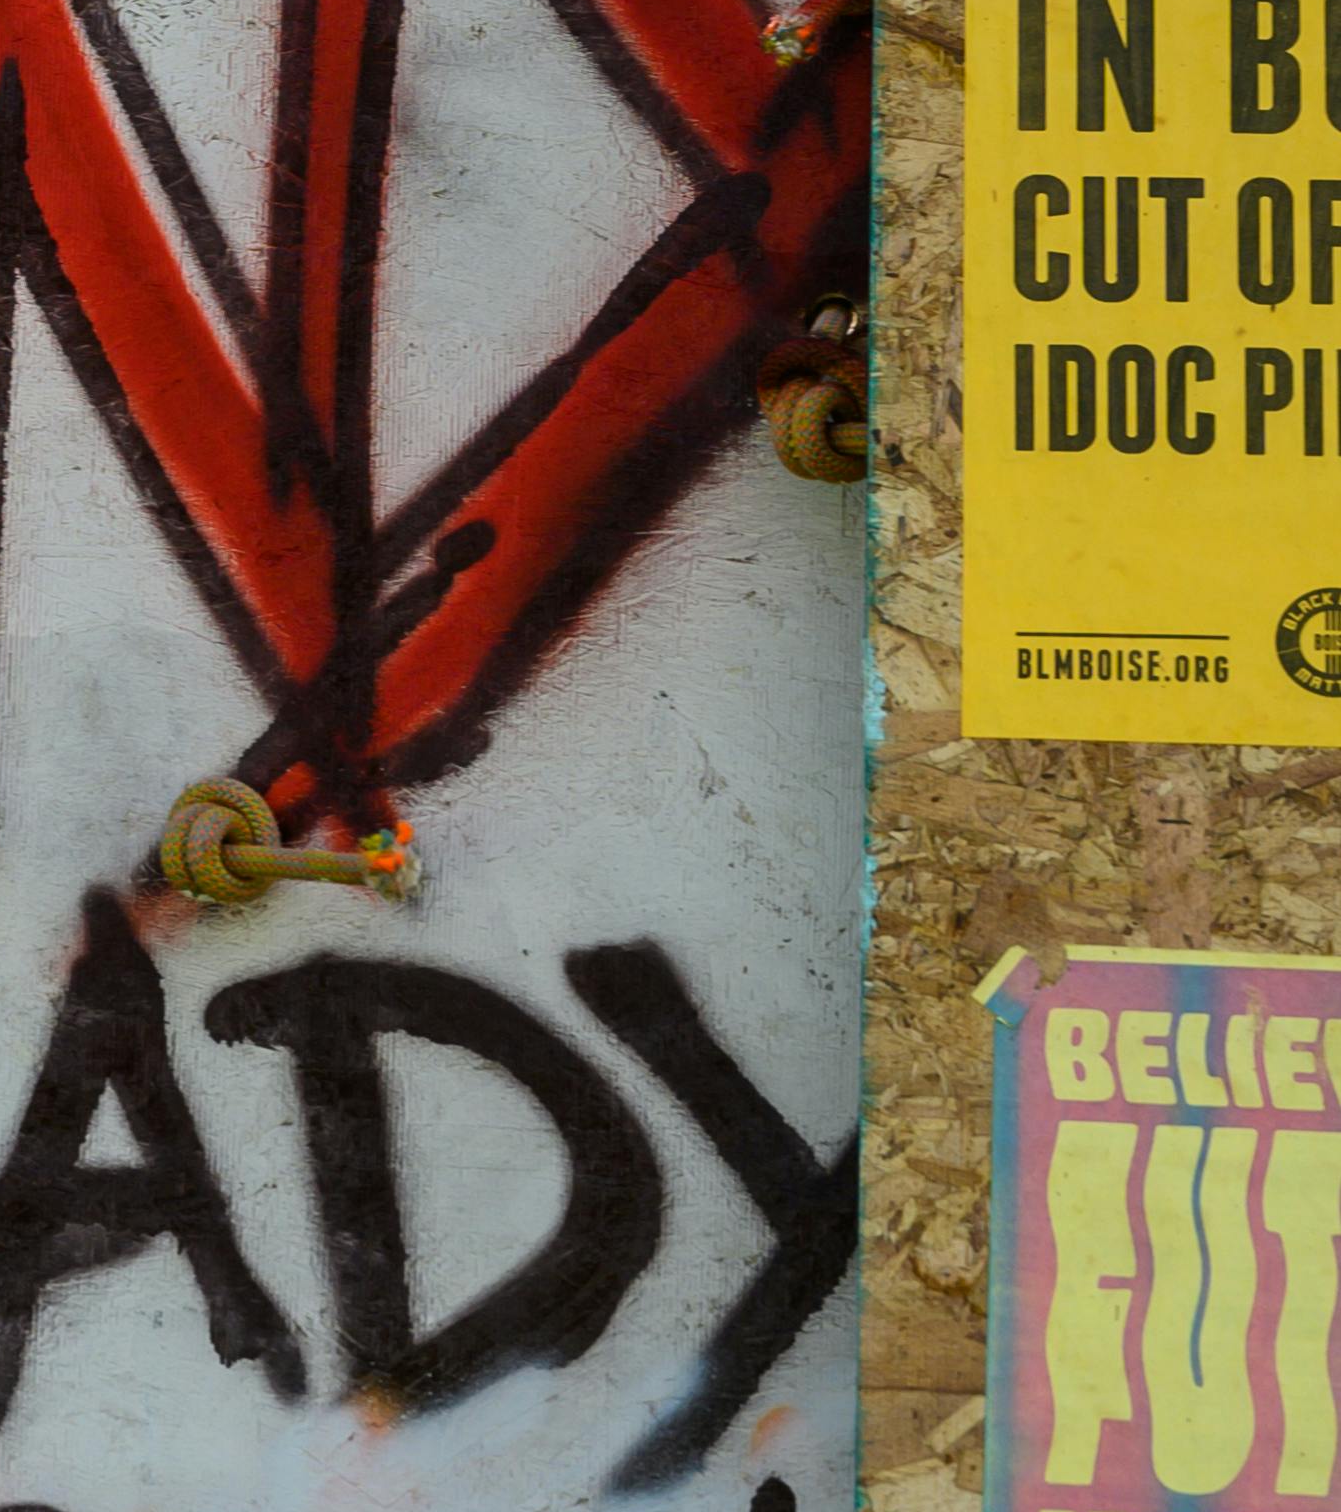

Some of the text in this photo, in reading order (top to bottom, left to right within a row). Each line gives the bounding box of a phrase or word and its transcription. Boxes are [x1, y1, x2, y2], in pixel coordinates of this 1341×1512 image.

[1013, 174, 1205, 303] CUT
[1014, 343, 1341, 457] IDOC PI
[1017, 647, 1229, 683] BLMBOISE.ORG
[1295, 666, 1341, 693] MAT
[1042, 1120, 1341, 1496] FUT
